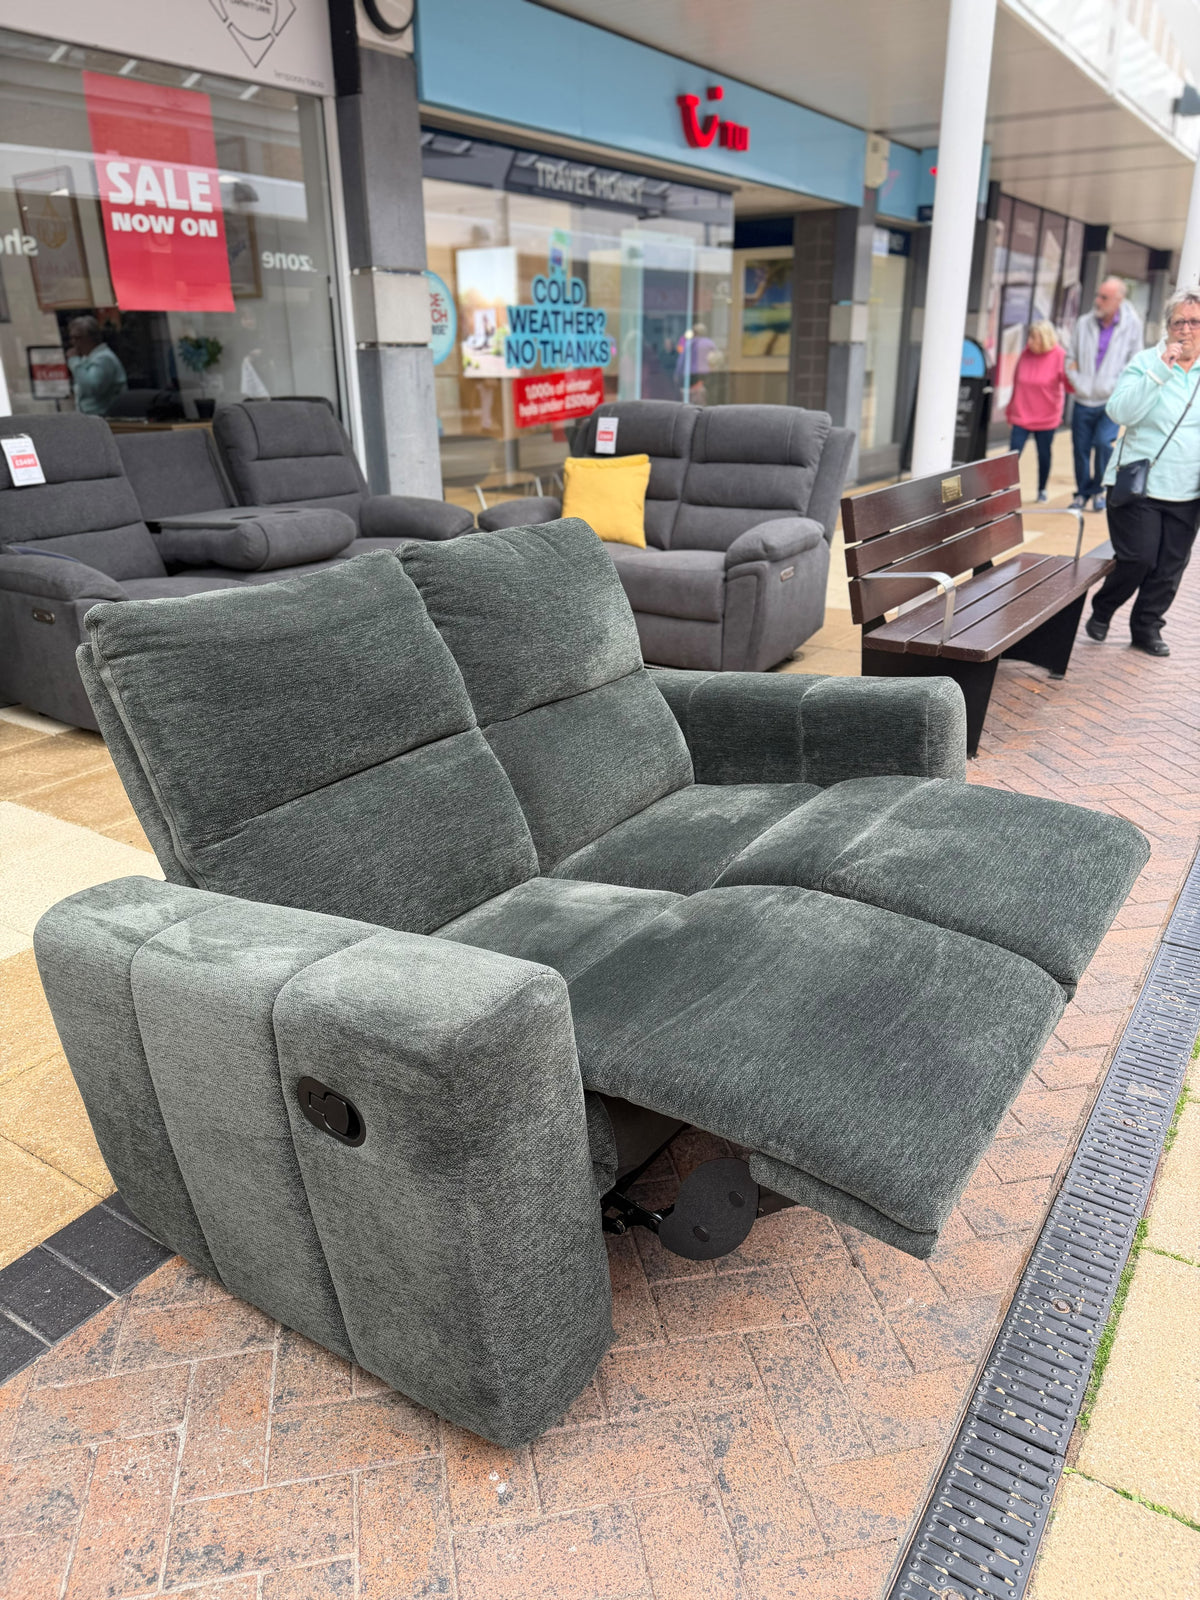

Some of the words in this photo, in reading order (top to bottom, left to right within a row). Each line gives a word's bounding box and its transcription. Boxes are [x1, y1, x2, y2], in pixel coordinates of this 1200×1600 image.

[106, 161, 214, 212] SALE
[534, 161, 593, 197] TRAVEL
[593, 174, 644, 204] MONEY
[111, 211, 174, 234] NOW
[180, 218, 218, 237] ON
[534, 278, 583, 304] COLD
[508, 308, 606, 335] WEATHER?
[507, 339, 536, 365] NO
[539, 339, 610, 364] THANKS
